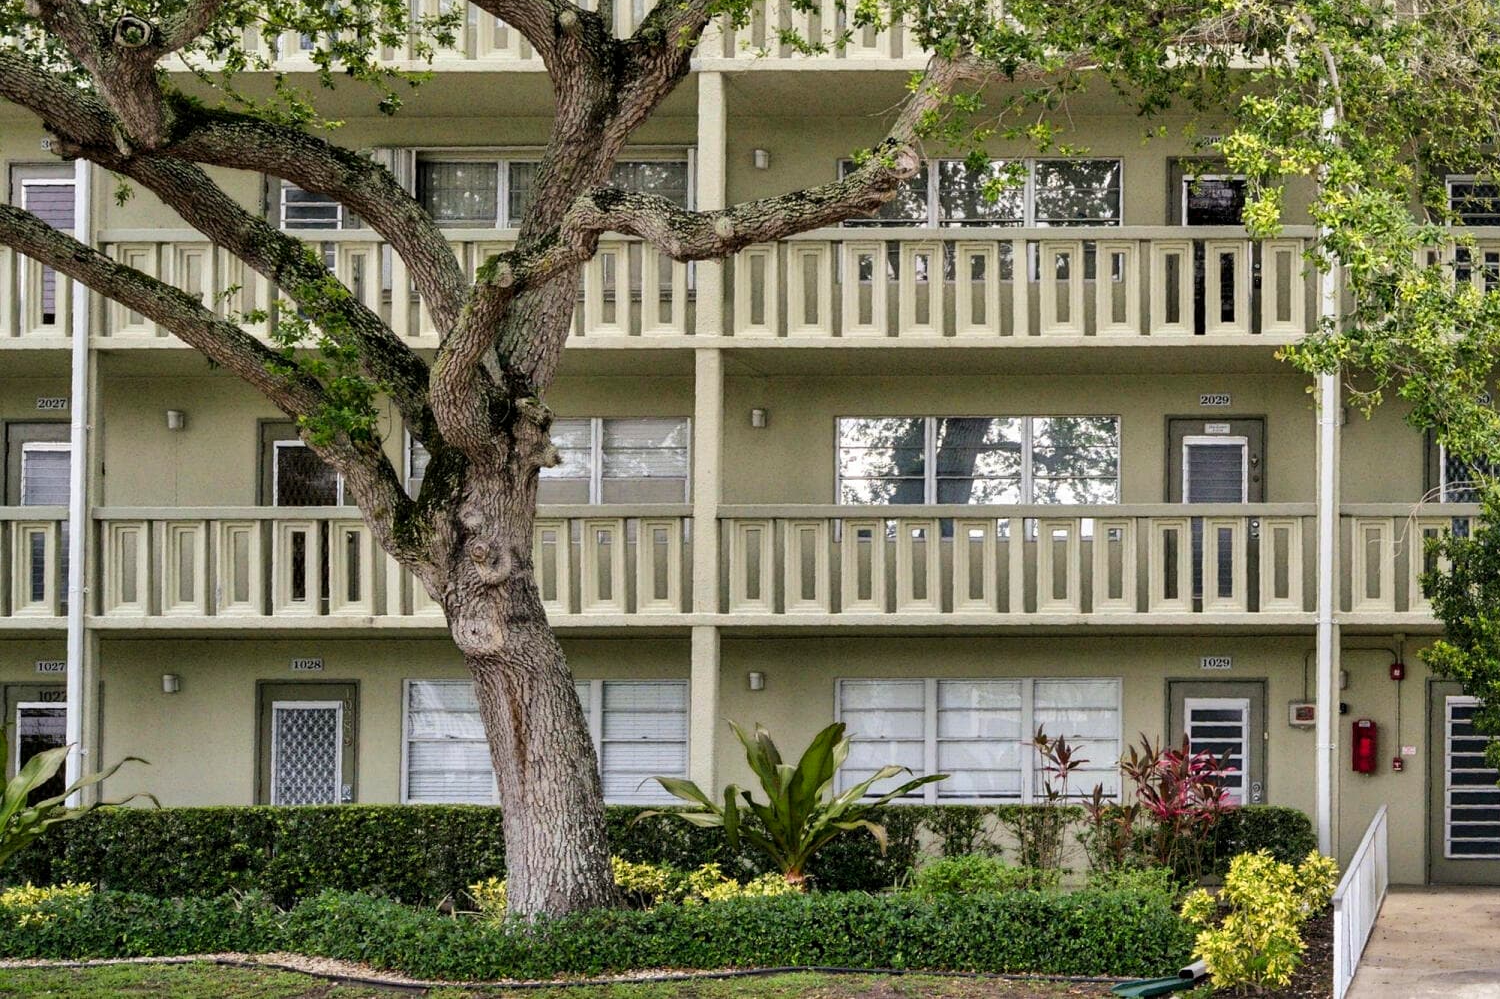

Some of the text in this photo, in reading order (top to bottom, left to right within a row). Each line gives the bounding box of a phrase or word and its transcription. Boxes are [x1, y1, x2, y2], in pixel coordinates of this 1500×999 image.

[38, 399, 67, 408] 2027
[1201, 395, 1230, 405] 2029
[39, 662, 66, 671] 1027
[293, 659, 322, 670] 1028
[1203, 658, 1230, 667] 1029
